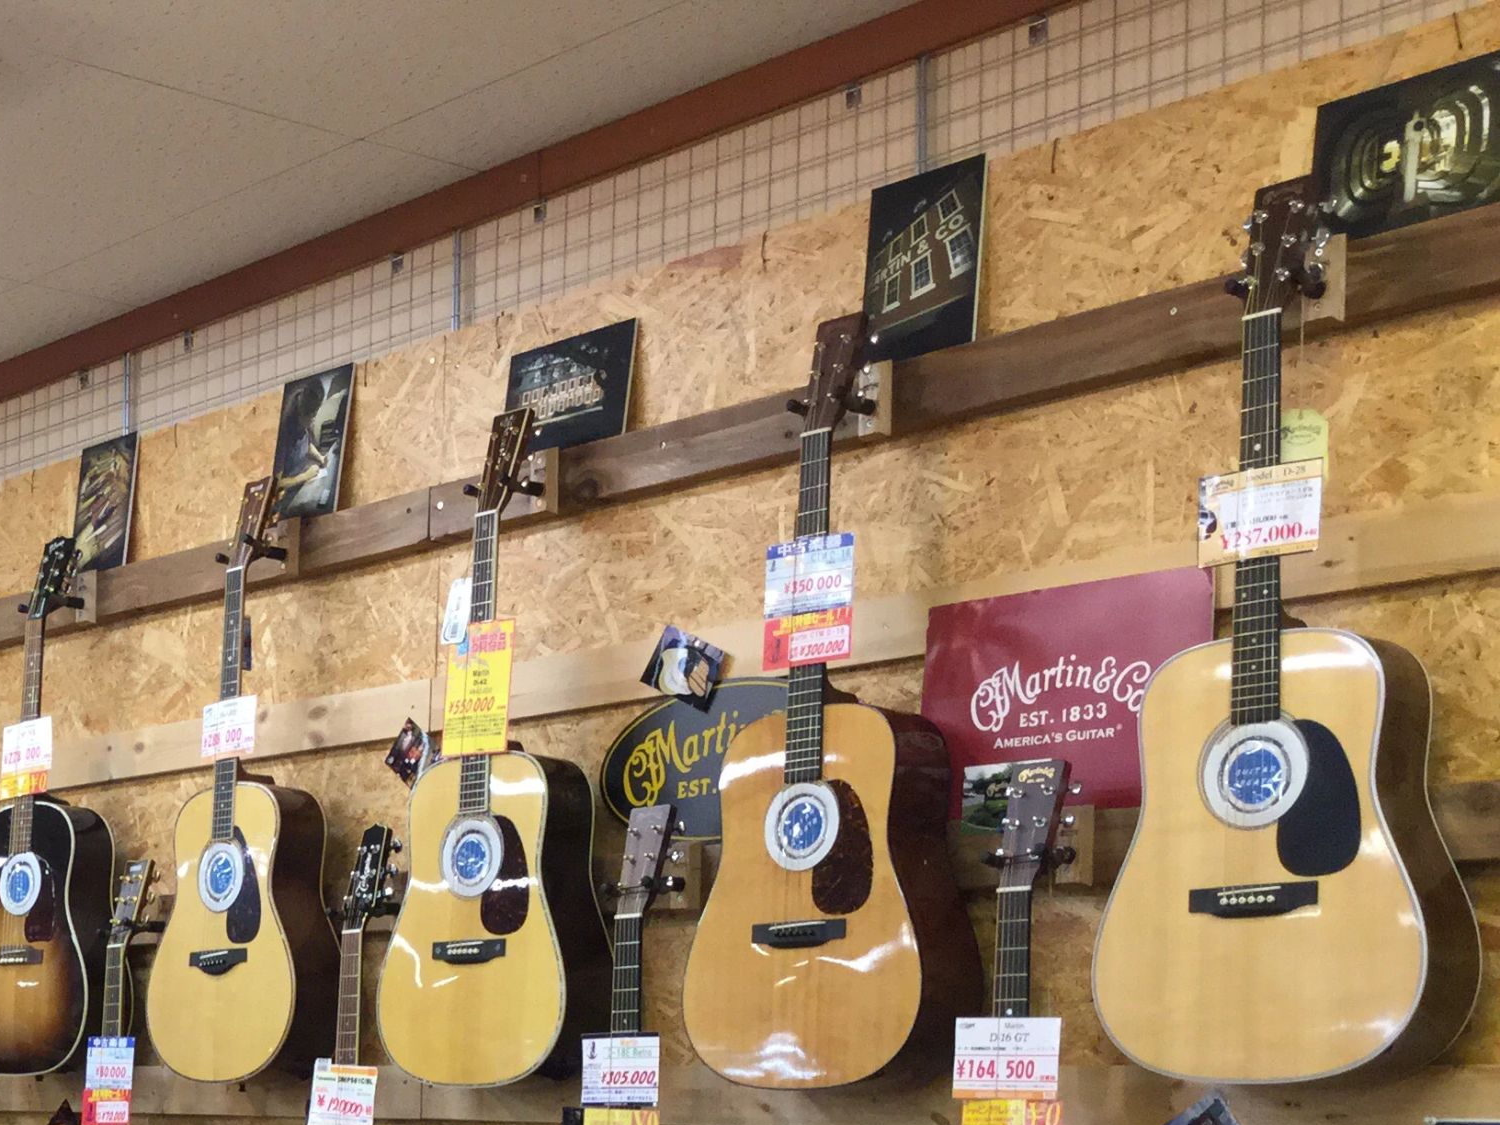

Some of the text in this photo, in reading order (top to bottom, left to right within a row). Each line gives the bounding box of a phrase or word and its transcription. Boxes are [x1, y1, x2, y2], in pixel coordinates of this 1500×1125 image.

[1019, 702, 1108, 728] EST. 1833
[993, 727, 1115, 749] AMERICA'S GUITAR
[677, 778, 718, 799] EST.
